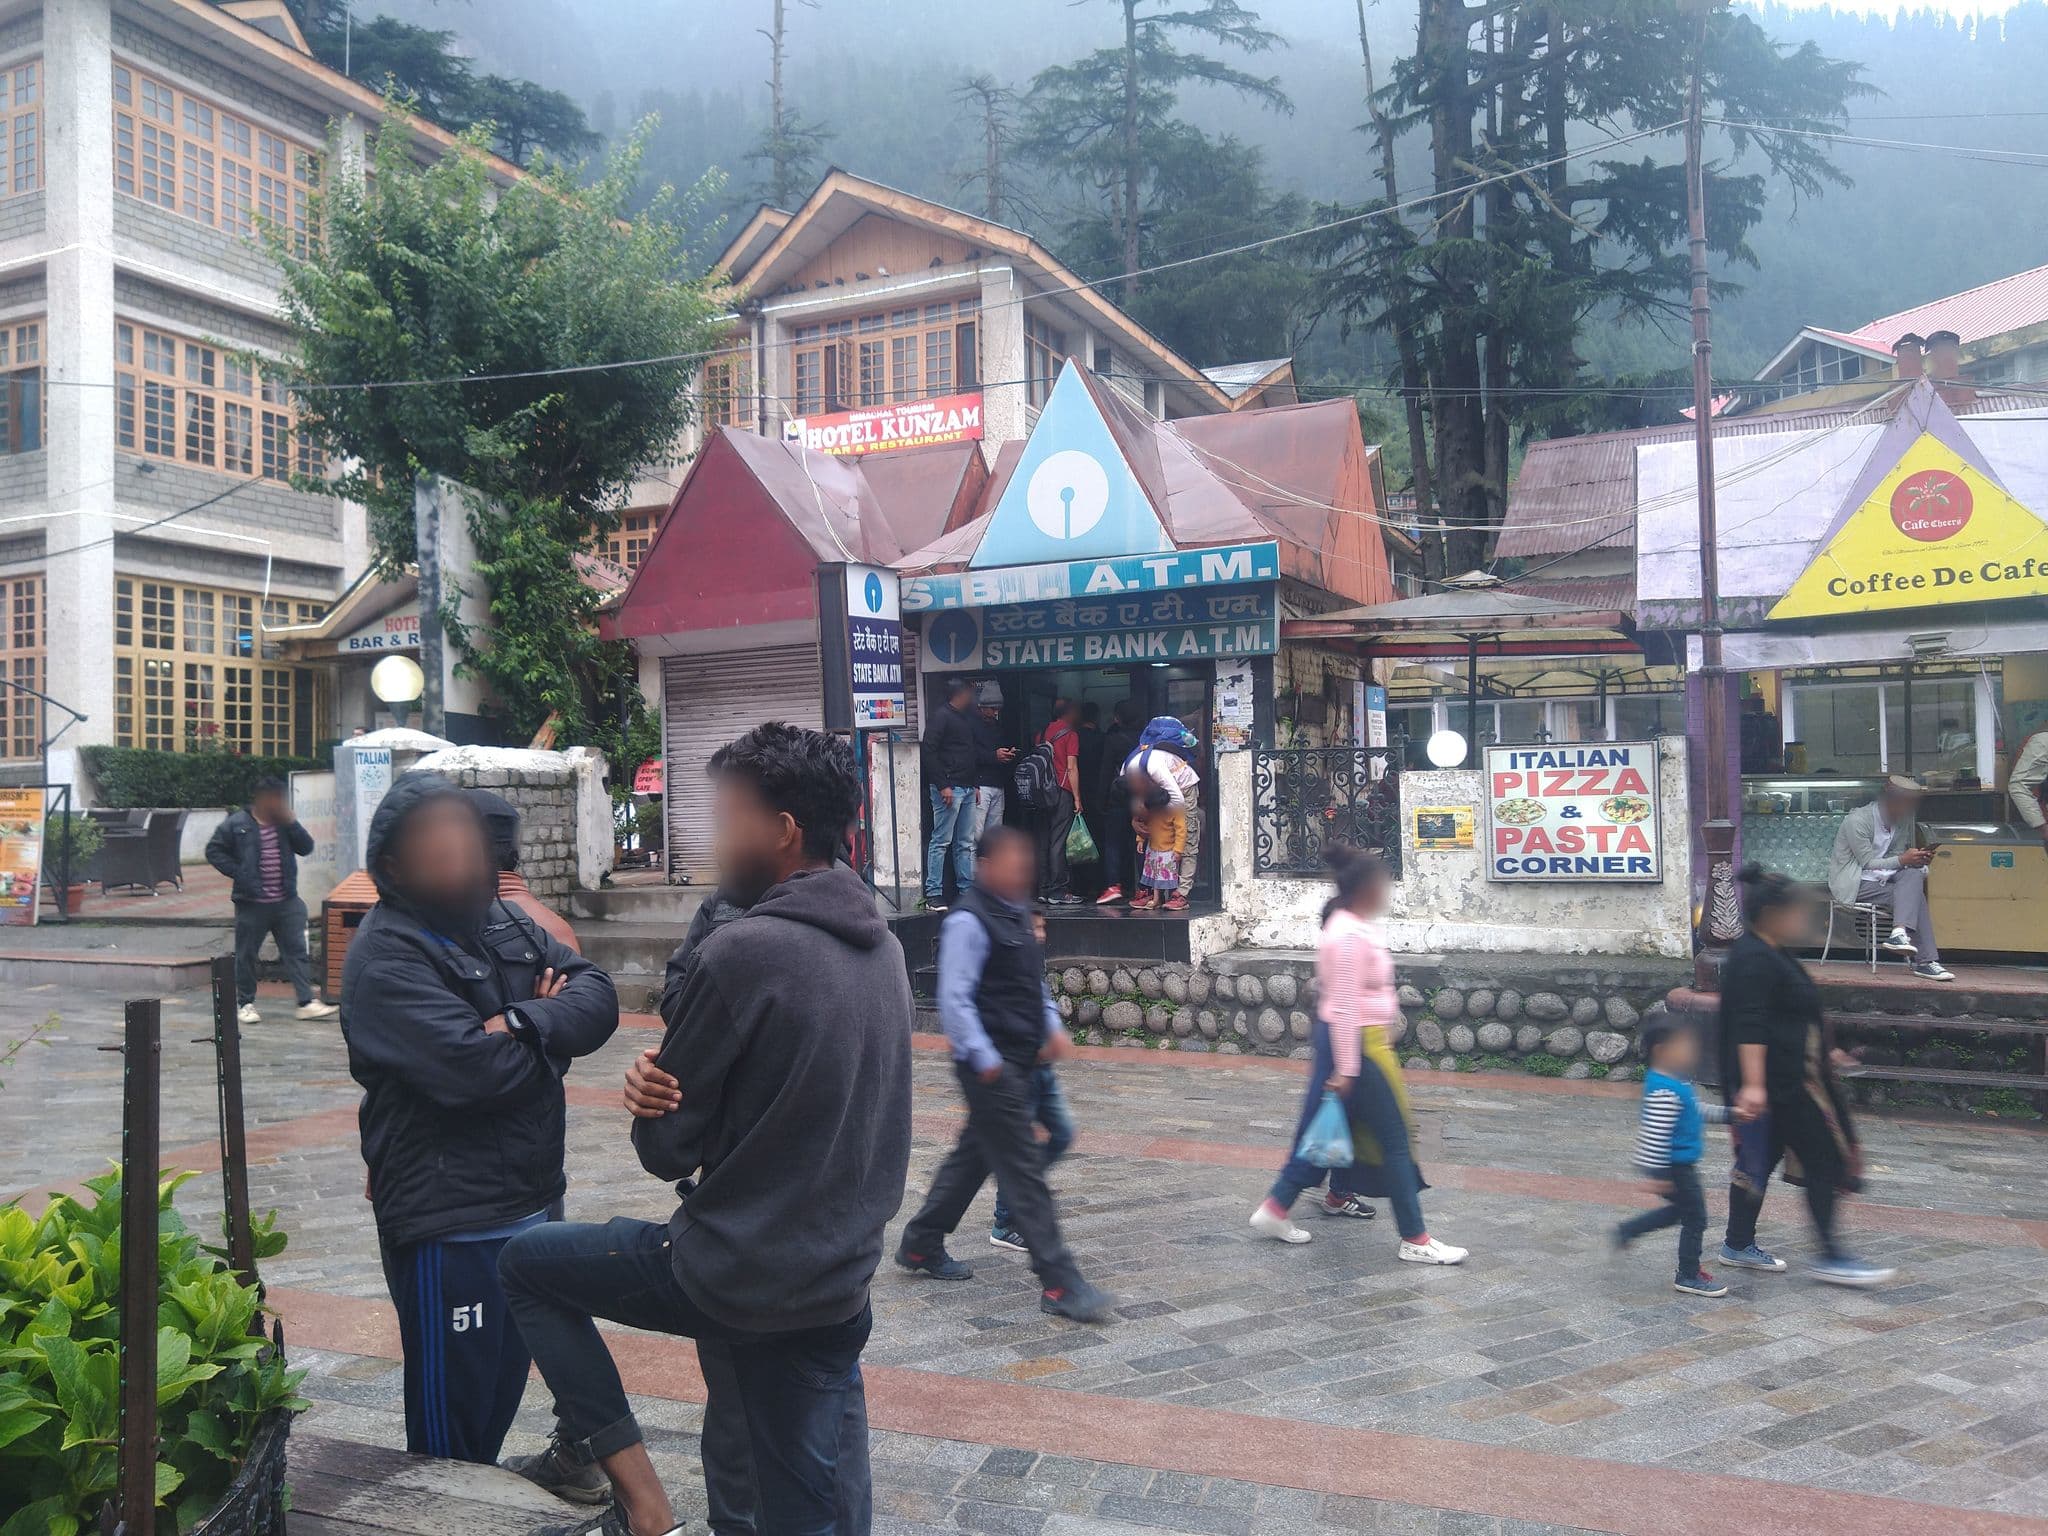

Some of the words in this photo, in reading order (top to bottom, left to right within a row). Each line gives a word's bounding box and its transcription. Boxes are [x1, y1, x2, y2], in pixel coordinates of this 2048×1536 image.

[895, 402, 936, 417] TOURISM
[807, 421, 877, 450] HOTEL
[881, 405, 980, 442] KUNZAM
[823, 443, 850, 456] BAR
[854, 442, 865, 453] &
[869, 431, 964, 450] RESTAURANT
[1901, 519, 1930, 531] Cafe
[1084, 550, 1272, 593] A.T.M.
[1827, 572, 1926, 597] Coffee
[1931, 567, 1974, 587] De
[1979, 558, 2048, 583] Cafe
[989, 605, 1047, 632] स्टेट
[350, 636, 384, 649] BAR
[390, 634, 402, 646] &
[986, 636, 1075, 666] STATE
[1084, 631, 1169, 661] BANK
[1177, 625, 1270, 655] A.T.M.
[853, 662, 872, 684] STATE
[872, 663, 889, 684] BANK
[890, 664, 902, 684] ATM
[855, 699, 870, 713] VISA
[355, 751, 390, 766] ITALIAN
[1510, 748, 1630, 770] ITALIAN
[1492, 768, 1650, 799] PIZZA
[1560, 805, 1583, 819] &
[1495, 825, 1653, 855] PASTA
[1495, 856, 1654, 874] CORNER
[453, 1302, 483, 1332] 51
